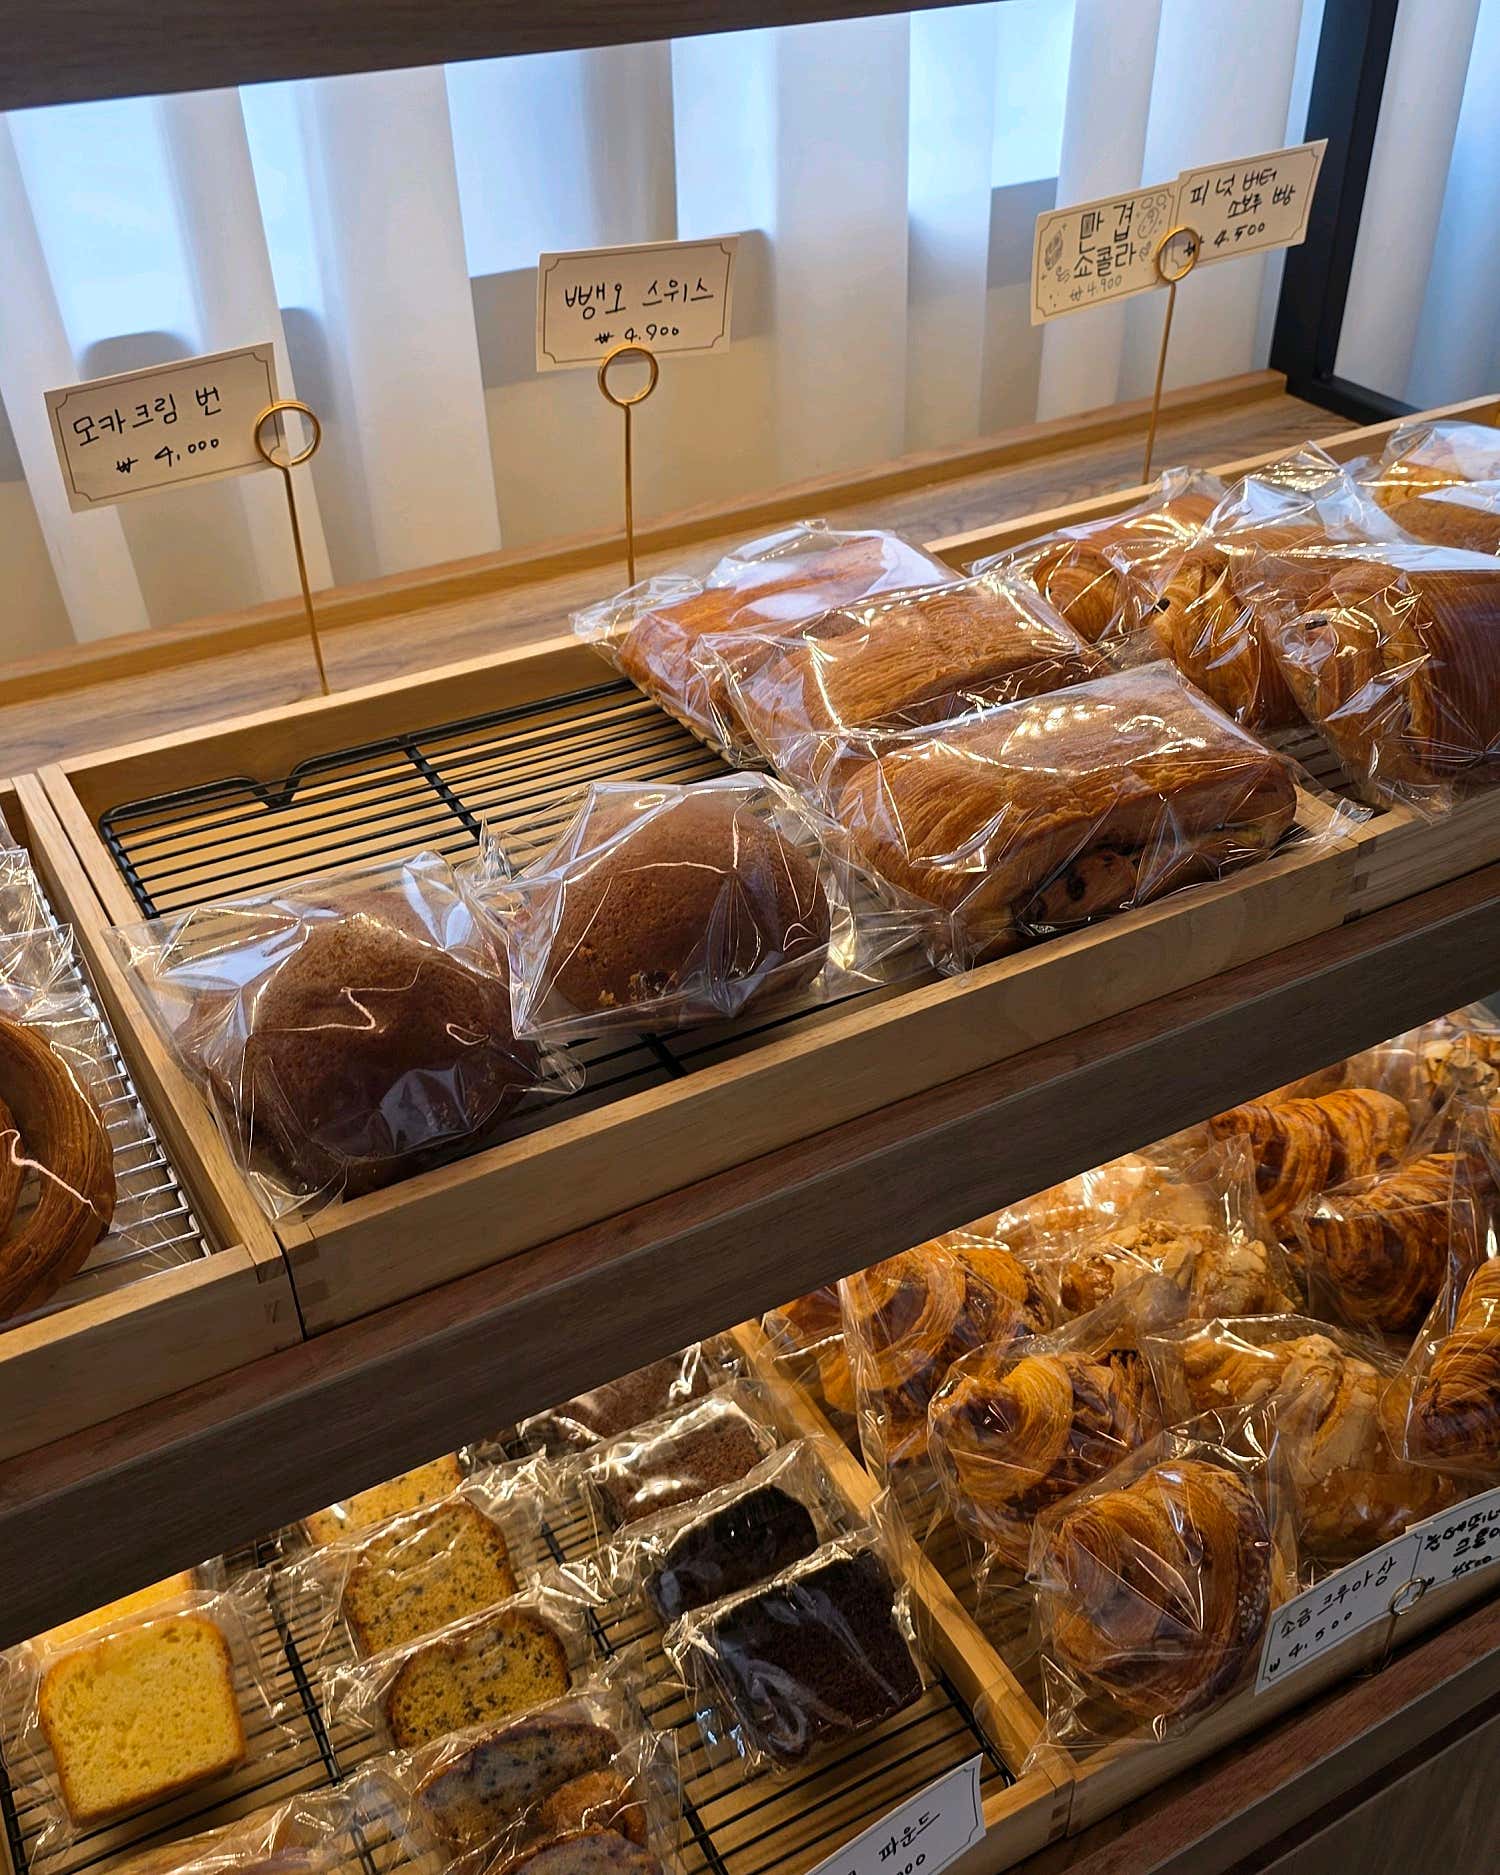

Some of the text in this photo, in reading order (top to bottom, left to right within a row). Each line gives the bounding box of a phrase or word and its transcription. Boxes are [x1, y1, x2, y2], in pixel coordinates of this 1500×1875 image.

[1271, 184, 1296, 206] 빵
[1073, 242, 1138, 279] 쇼콜라
[564, 277, 715, 320] 뺑오 스위스
[72, 385, 223, 447] 모카크림 번
[1280, 1556, 1398, 1639] 소금 크루아상
[877, 1810, 942, 1863] 파운드
